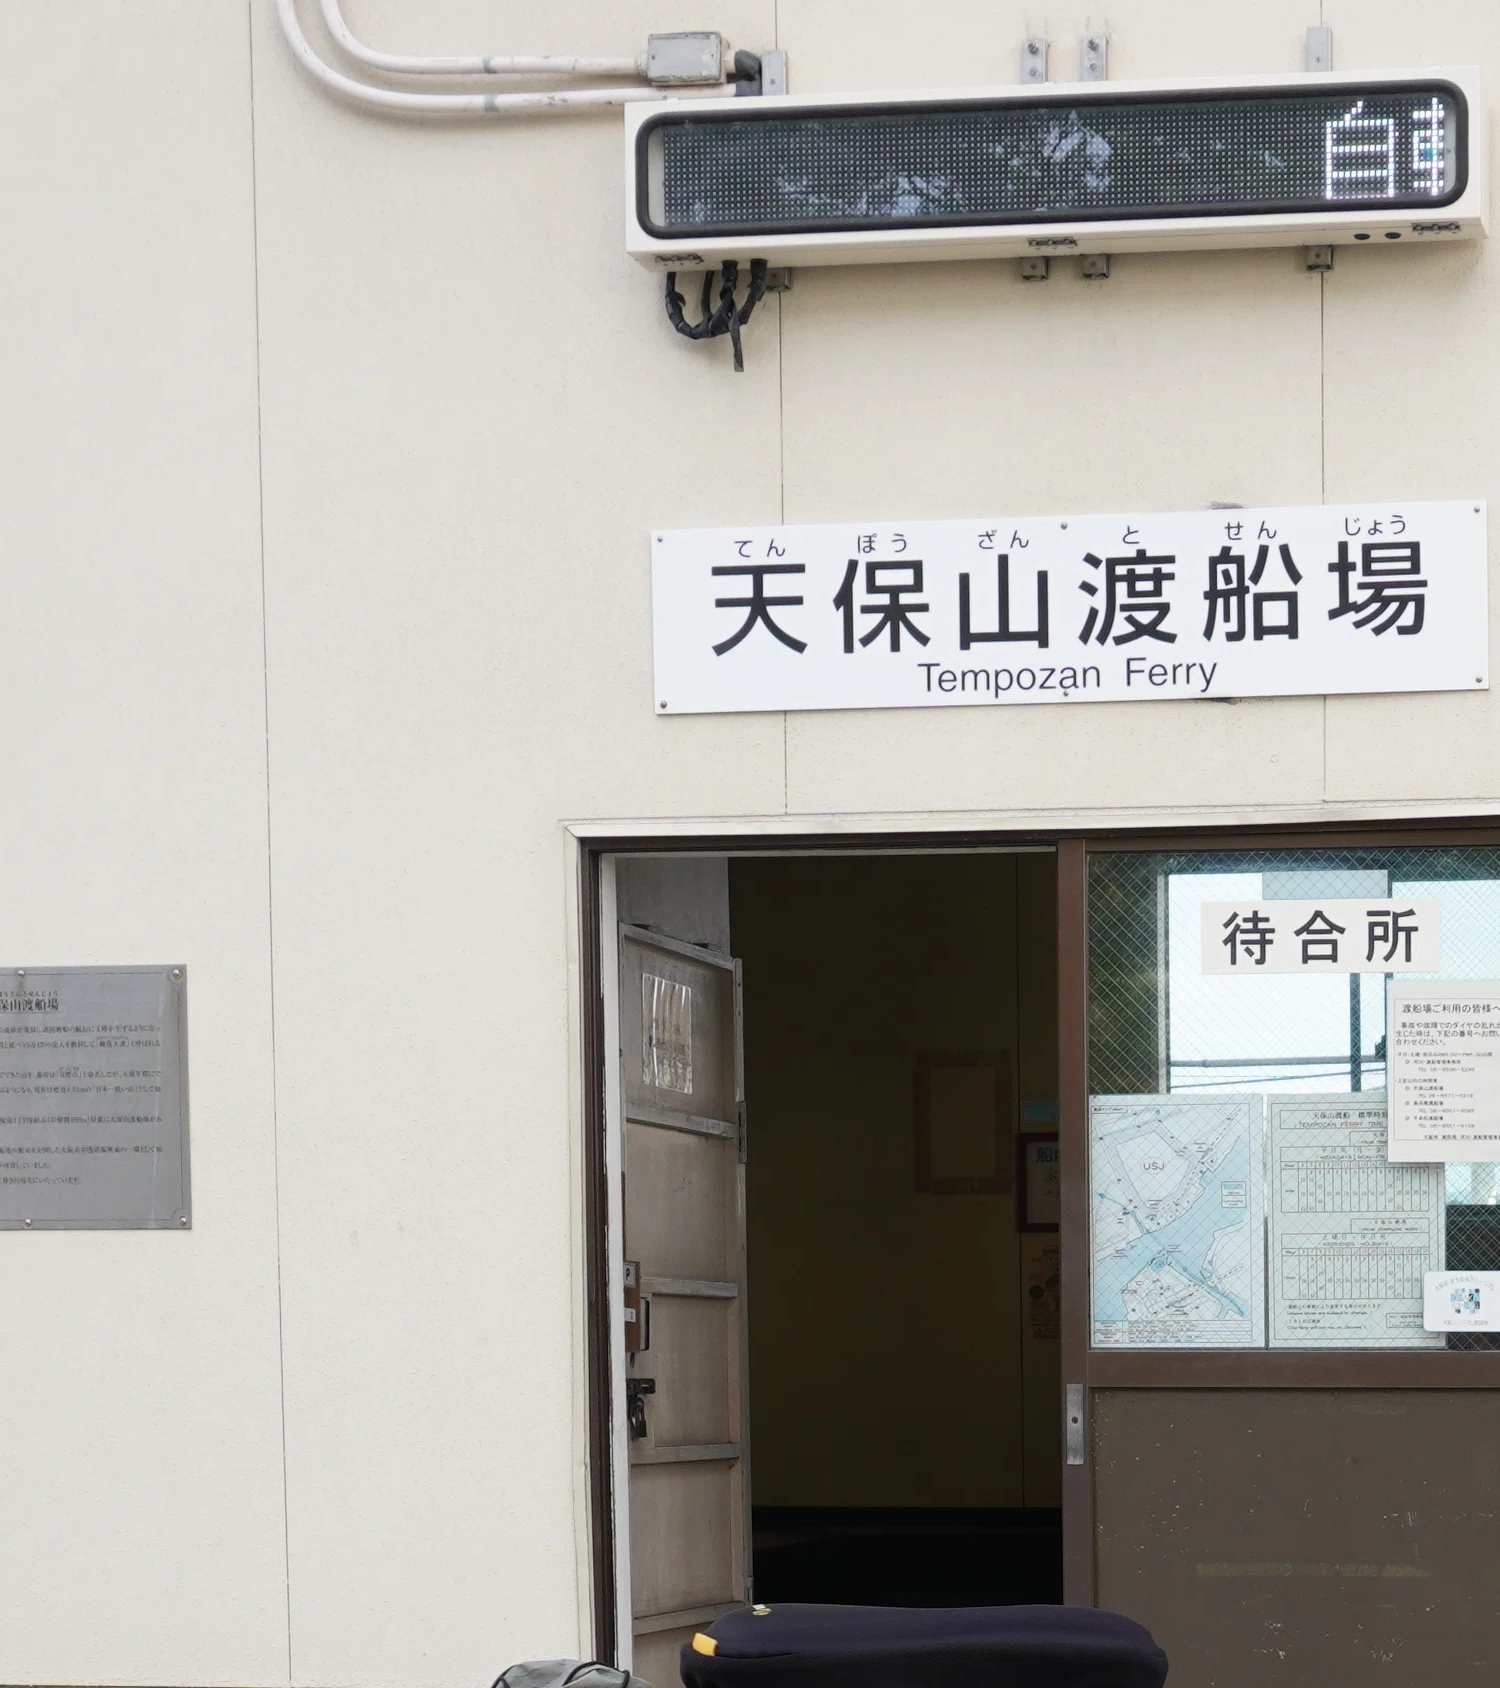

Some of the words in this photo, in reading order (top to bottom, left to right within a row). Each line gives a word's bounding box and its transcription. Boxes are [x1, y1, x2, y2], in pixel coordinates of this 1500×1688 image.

[734, 538, 786, 558] てん
[856, 533, 908, 554] ぽう
[977, 529, 1029, 551] ざん
[1121, 525, 1140, 545] と
[1224, 520, 1277, 541] せん
[1344, 514, 1406, 537] じょう
[711, 541, 1428, 657] 天保山渡船場
[917, 662, 1101, 699] Tempozan
[1126, 656, 1218, 692] Ferry
[1222, 908, 1419, 966] 待合所
[1143, 1160, 1165, 1171] USJ
